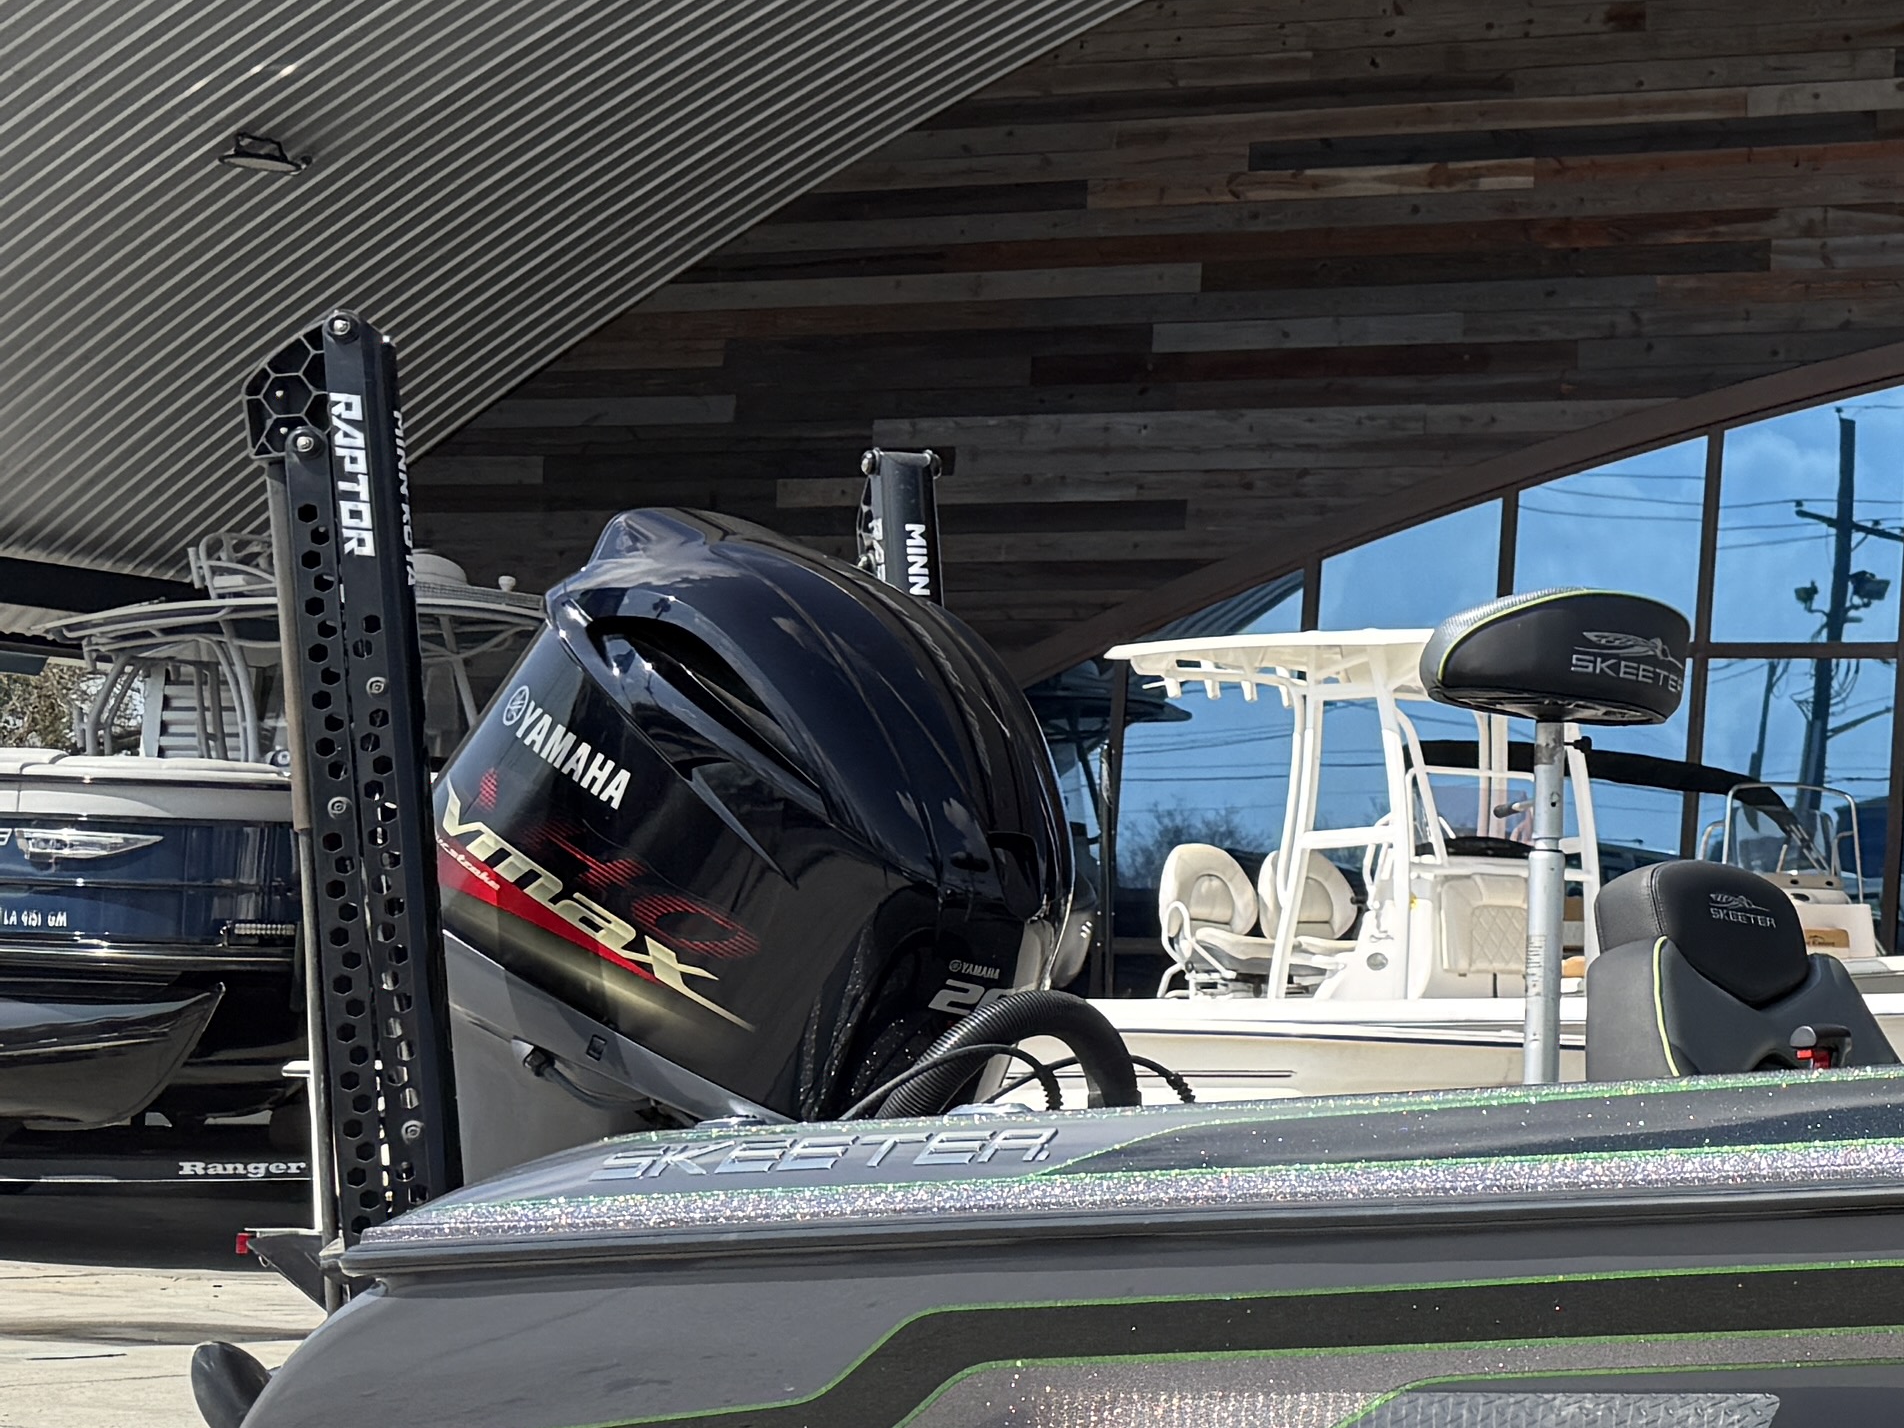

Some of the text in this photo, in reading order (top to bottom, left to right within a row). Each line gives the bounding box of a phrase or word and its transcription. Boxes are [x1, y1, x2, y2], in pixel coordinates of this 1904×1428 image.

[329, 392, 376, 557] RAPTOR
[904, 523, 931, 596] MINN
[515, 700, 632, 810] YAMAHA
[1710, 907, 1776, 928] SKEETER
[961, 962, 1000, 980] YAMAHA
[178, 1161, 307, 1177] Ranger
[588, 1127, 1059, 1182] SKEETER
